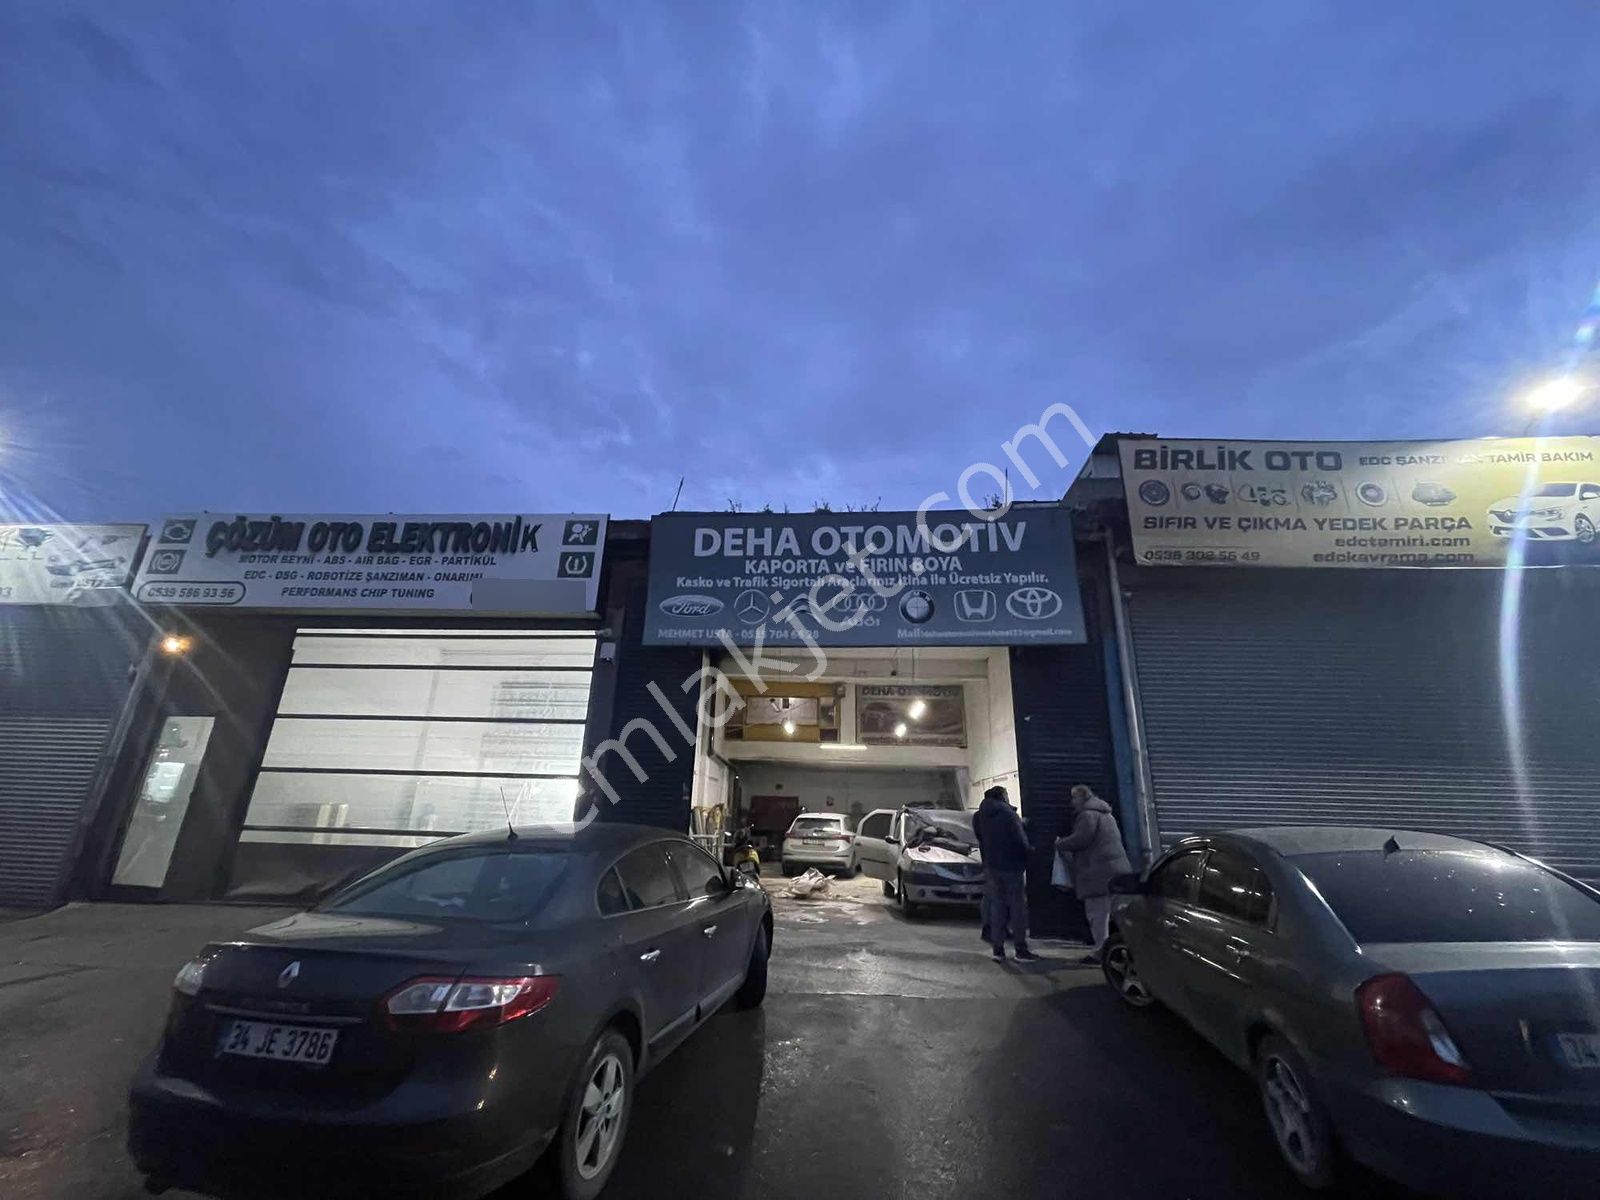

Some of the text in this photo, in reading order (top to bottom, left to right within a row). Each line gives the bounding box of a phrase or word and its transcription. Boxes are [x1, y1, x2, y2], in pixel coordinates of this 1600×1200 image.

[1133, 446, 1342, 471] BİRLİK OTO
[1359, 456, 1391, 466] EDC
[1489, 451, 1537, 463] TAMİR
[1541, 451, 1593, 462] BAKIM
[1143, 516, 1472, 532] SIFIR VE ÇIKMA YEDEK PARÇA
[205, 514, 542, 558] ÇÖZÜM OTO ELEKTRONİK
[693, 516, 1026, 557] DEHA OTOMOTİV
[1335, 535, 1470, 548] edctamiri.com
[238, 555, 278, 564] MOTOR
[323, 555, 346, 565] ABS
[354, 556, 375, 565] AIR
[376, 556, 400, 565] BAG
[409, 556, 432, 566] EGR
[745, 556, 963, 574] KAPORTA ve FIRIN BOYA
[243, 570, 267, 580] EDC
[275, 570, 298, 580] DSG
[306, 570, 363, 581] ROBOTİZE
[366, 571, 425, 583] ŞANZIMAN
[676, 576, 713, 587] Kasko
[716, 578, 731, 587] ve
[732, 576, 768, 587] Trafik
[949, 572, 1002, 585] Ücretsiz
[280, 587, 435, 598] PERFORMANS CHIP TUNING
[657, 629, 704, 639] MEHMET
[229, 1023, 331, 1060] 34 JE 3786
